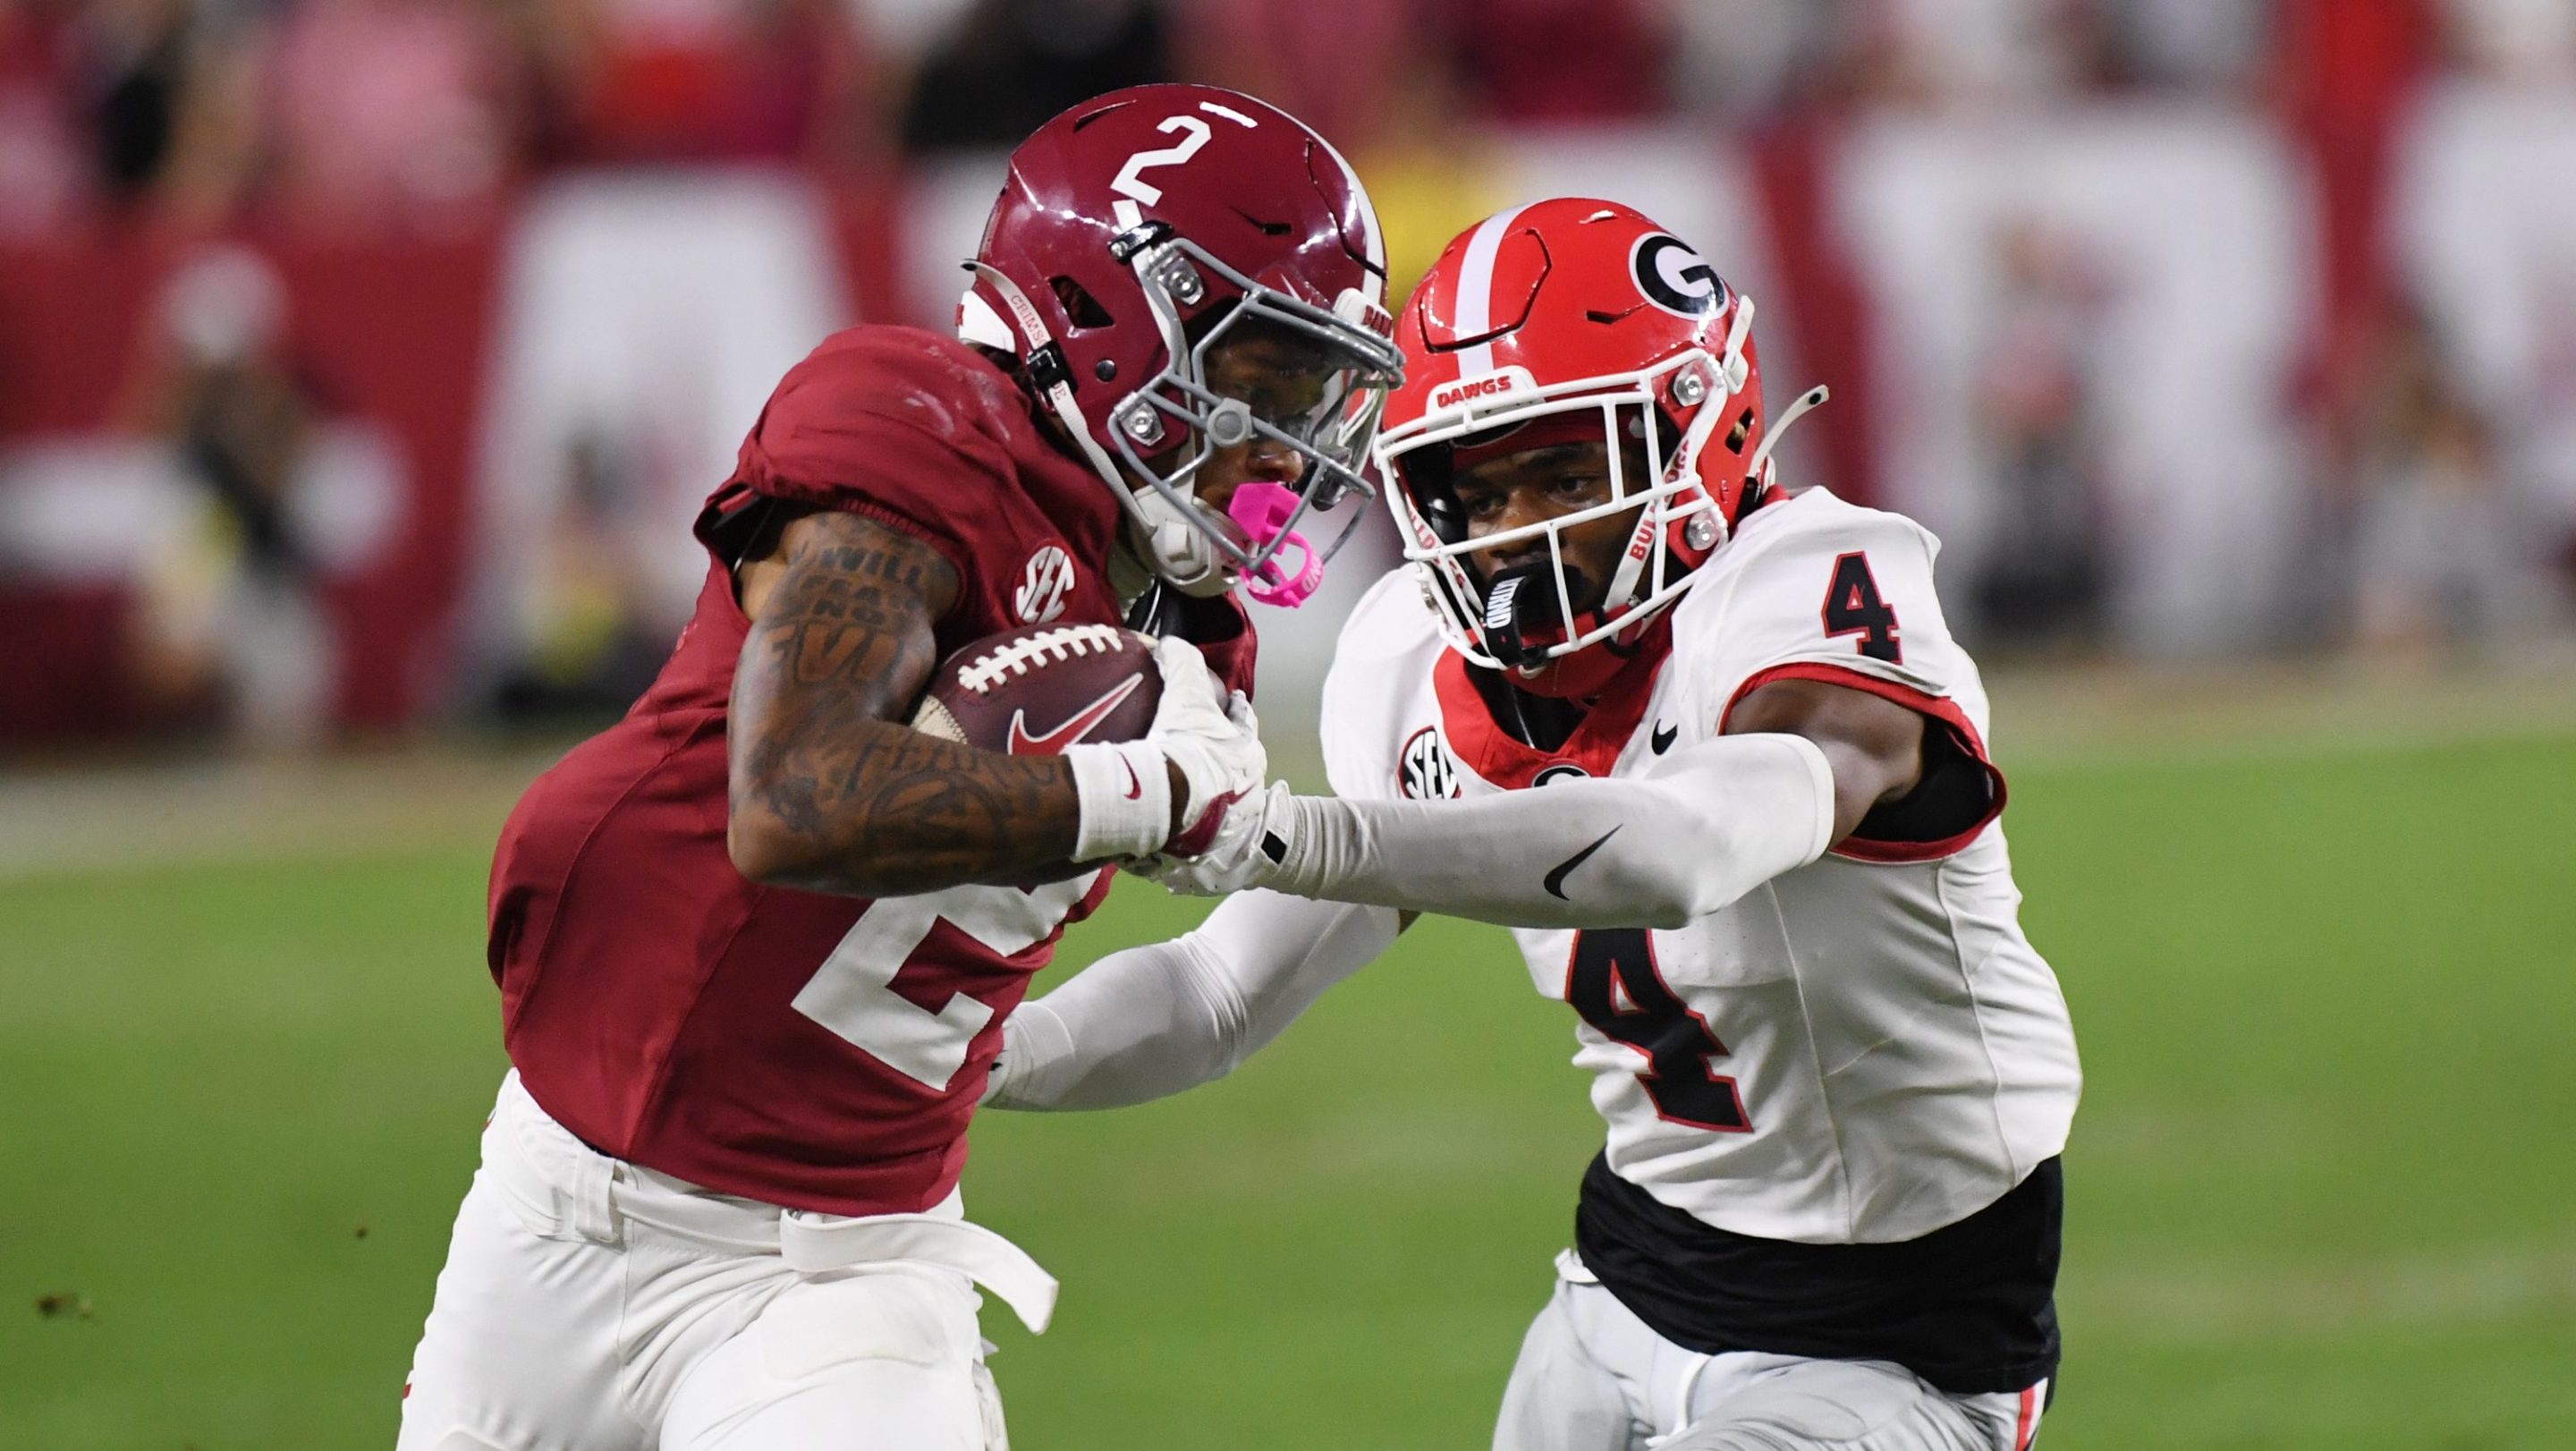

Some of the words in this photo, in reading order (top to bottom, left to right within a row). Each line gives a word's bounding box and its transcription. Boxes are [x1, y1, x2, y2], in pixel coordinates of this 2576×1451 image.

[1110, 115, 1211, 207] 2
[1631, 233, 1728, 319] G
[1436, 375, 1513, 408] DAWGS
[1016, 546, 1074, 624] SEC
[1821, 551, 1902, 666] 4
[791, 866, 1104, 1092] 2
[1565, 928, 1754, 1133] 4
